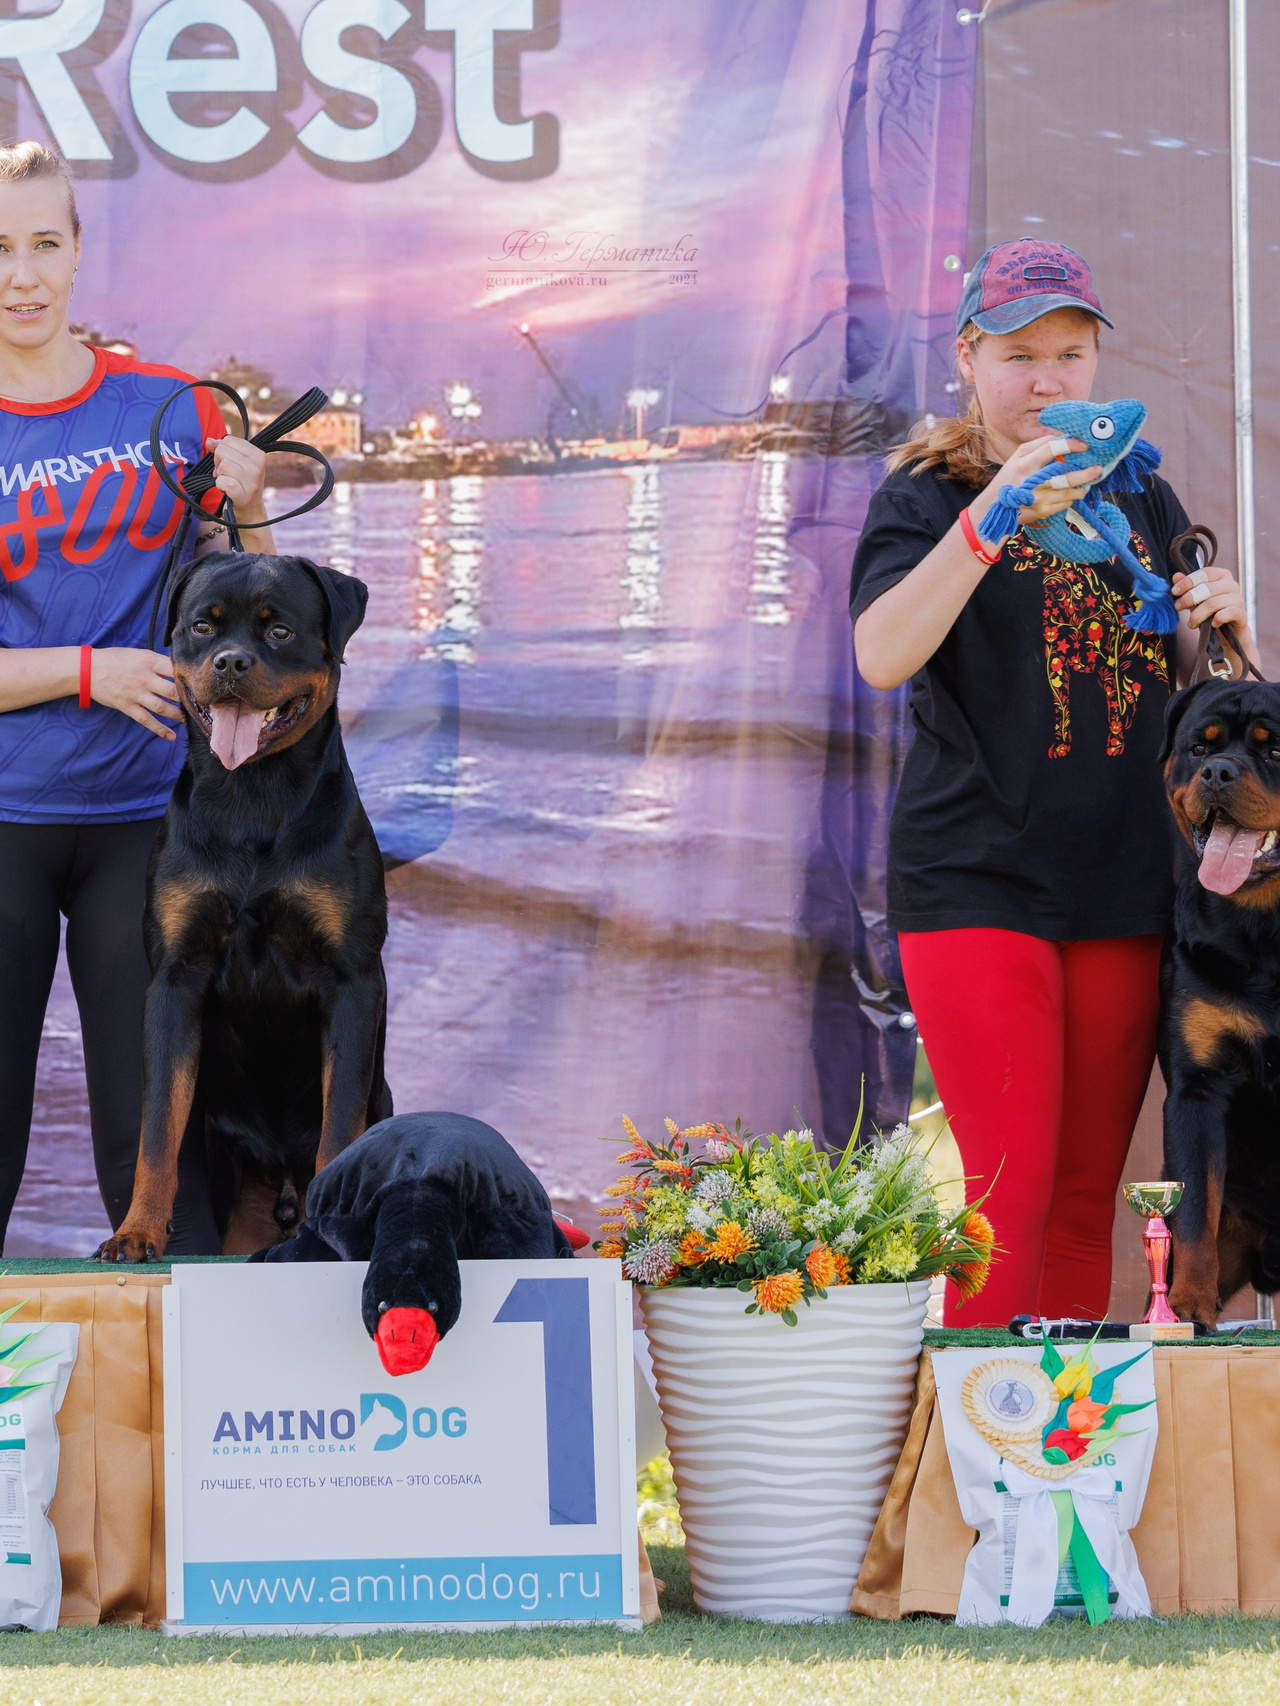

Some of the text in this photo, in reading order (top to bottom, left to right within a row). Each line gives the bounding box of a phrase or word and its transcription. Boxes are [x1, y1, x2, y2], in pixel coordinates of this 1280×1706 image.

[492, 1277, 597, 1526] 1
[212, 1443, 357, 1455] КОРМА ДЛЯ СОБАК
[200, 1478, 255, 1491] ЛУЧШЕЕ,
[259, 1478, 282, 1489] ЧТО
[286, 1477, 316, 1489] ЕСТЬ
[318, 1477, 327, 1488] У
[329, 1475, 393, 1487] ЧЕЛОВЕКА
[406, 1475, 430, 1486] ЭТО
[433, 1473, 482, 1485] СОБАКА
[210, 1563, 601, 1610] www.aminodog.ru
